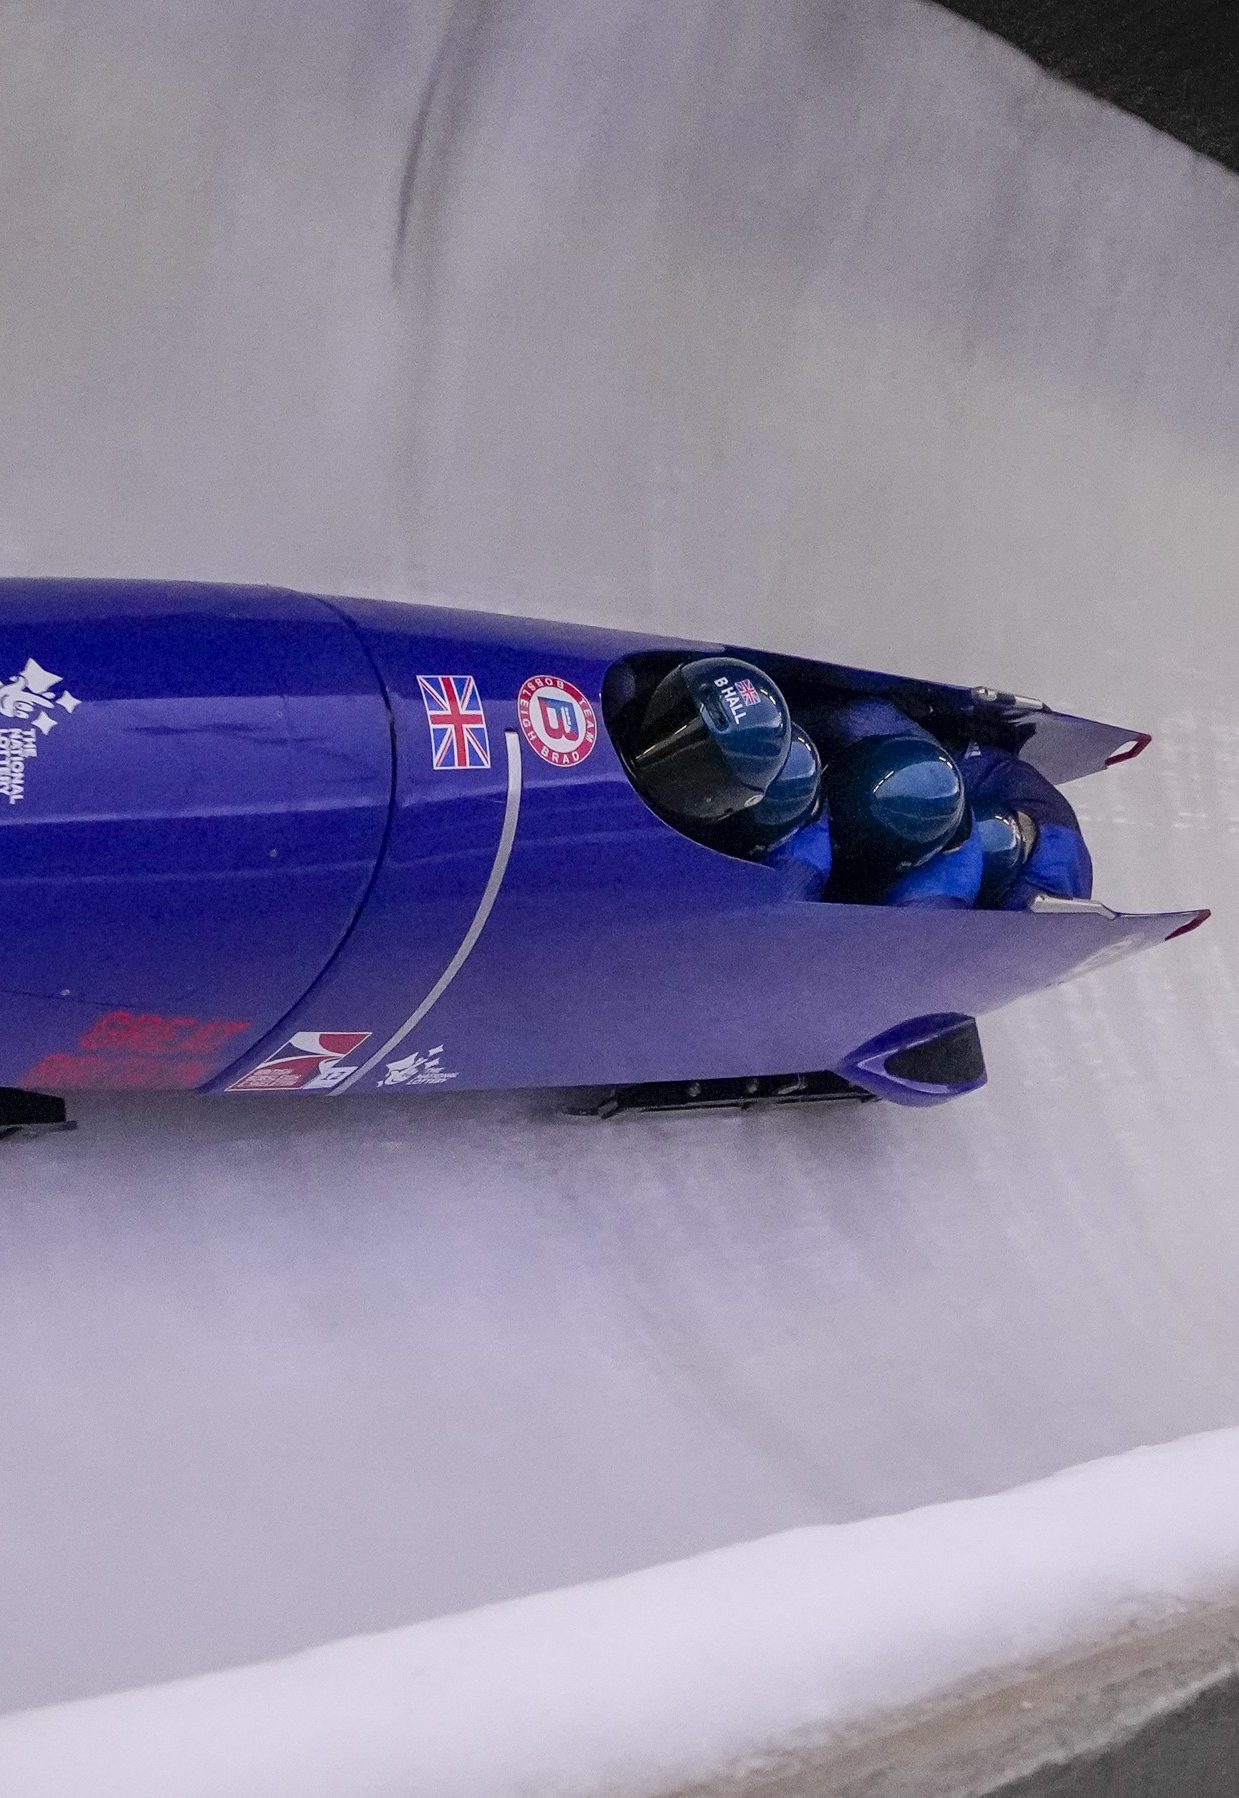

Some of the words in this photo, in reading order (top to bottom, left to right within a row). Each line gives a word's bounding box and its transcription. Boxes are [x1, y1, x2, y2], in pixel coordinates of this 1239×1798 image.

[714, 676, 729, 688] B
[520, 677, 564, 741] BOBSLEIGH
[579, 698, 595, 743] TEAM
[721, 686, 747, 725] HALL
[22, 728, 38, 757] THE
[541, 746, 580, 764] BRAD
[10, 728, 25, 805] NATIONAL
